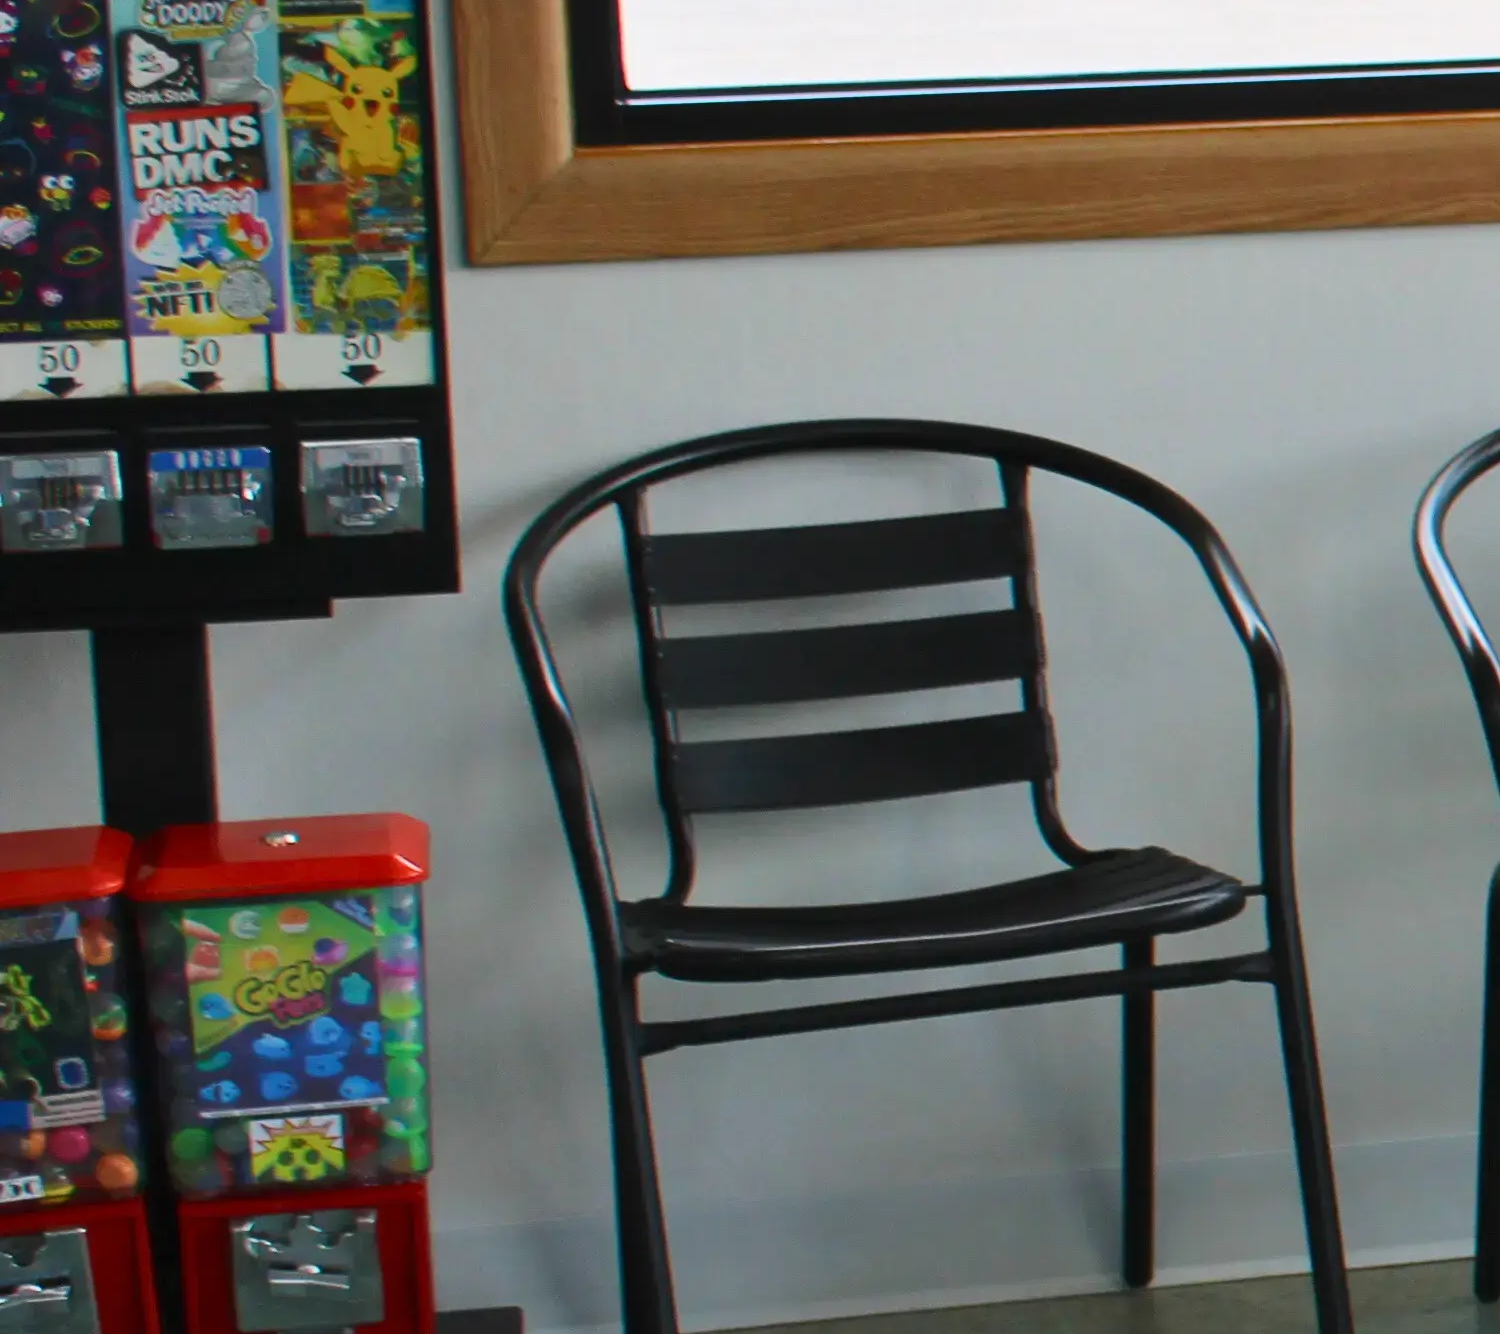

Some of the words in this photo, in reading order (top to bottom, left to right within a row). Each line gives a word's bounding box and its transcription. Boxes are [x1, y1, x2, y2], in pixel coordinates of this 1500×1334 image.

[128, 115, 261, 156] RUNS
[133, 150, 233, 189] DMC
[147, 292, 215, 317] NFT!
[39, 345, 81, 373] 50
[181, 339, 222, 367] 50
[342, 333, 382, 361] 50
